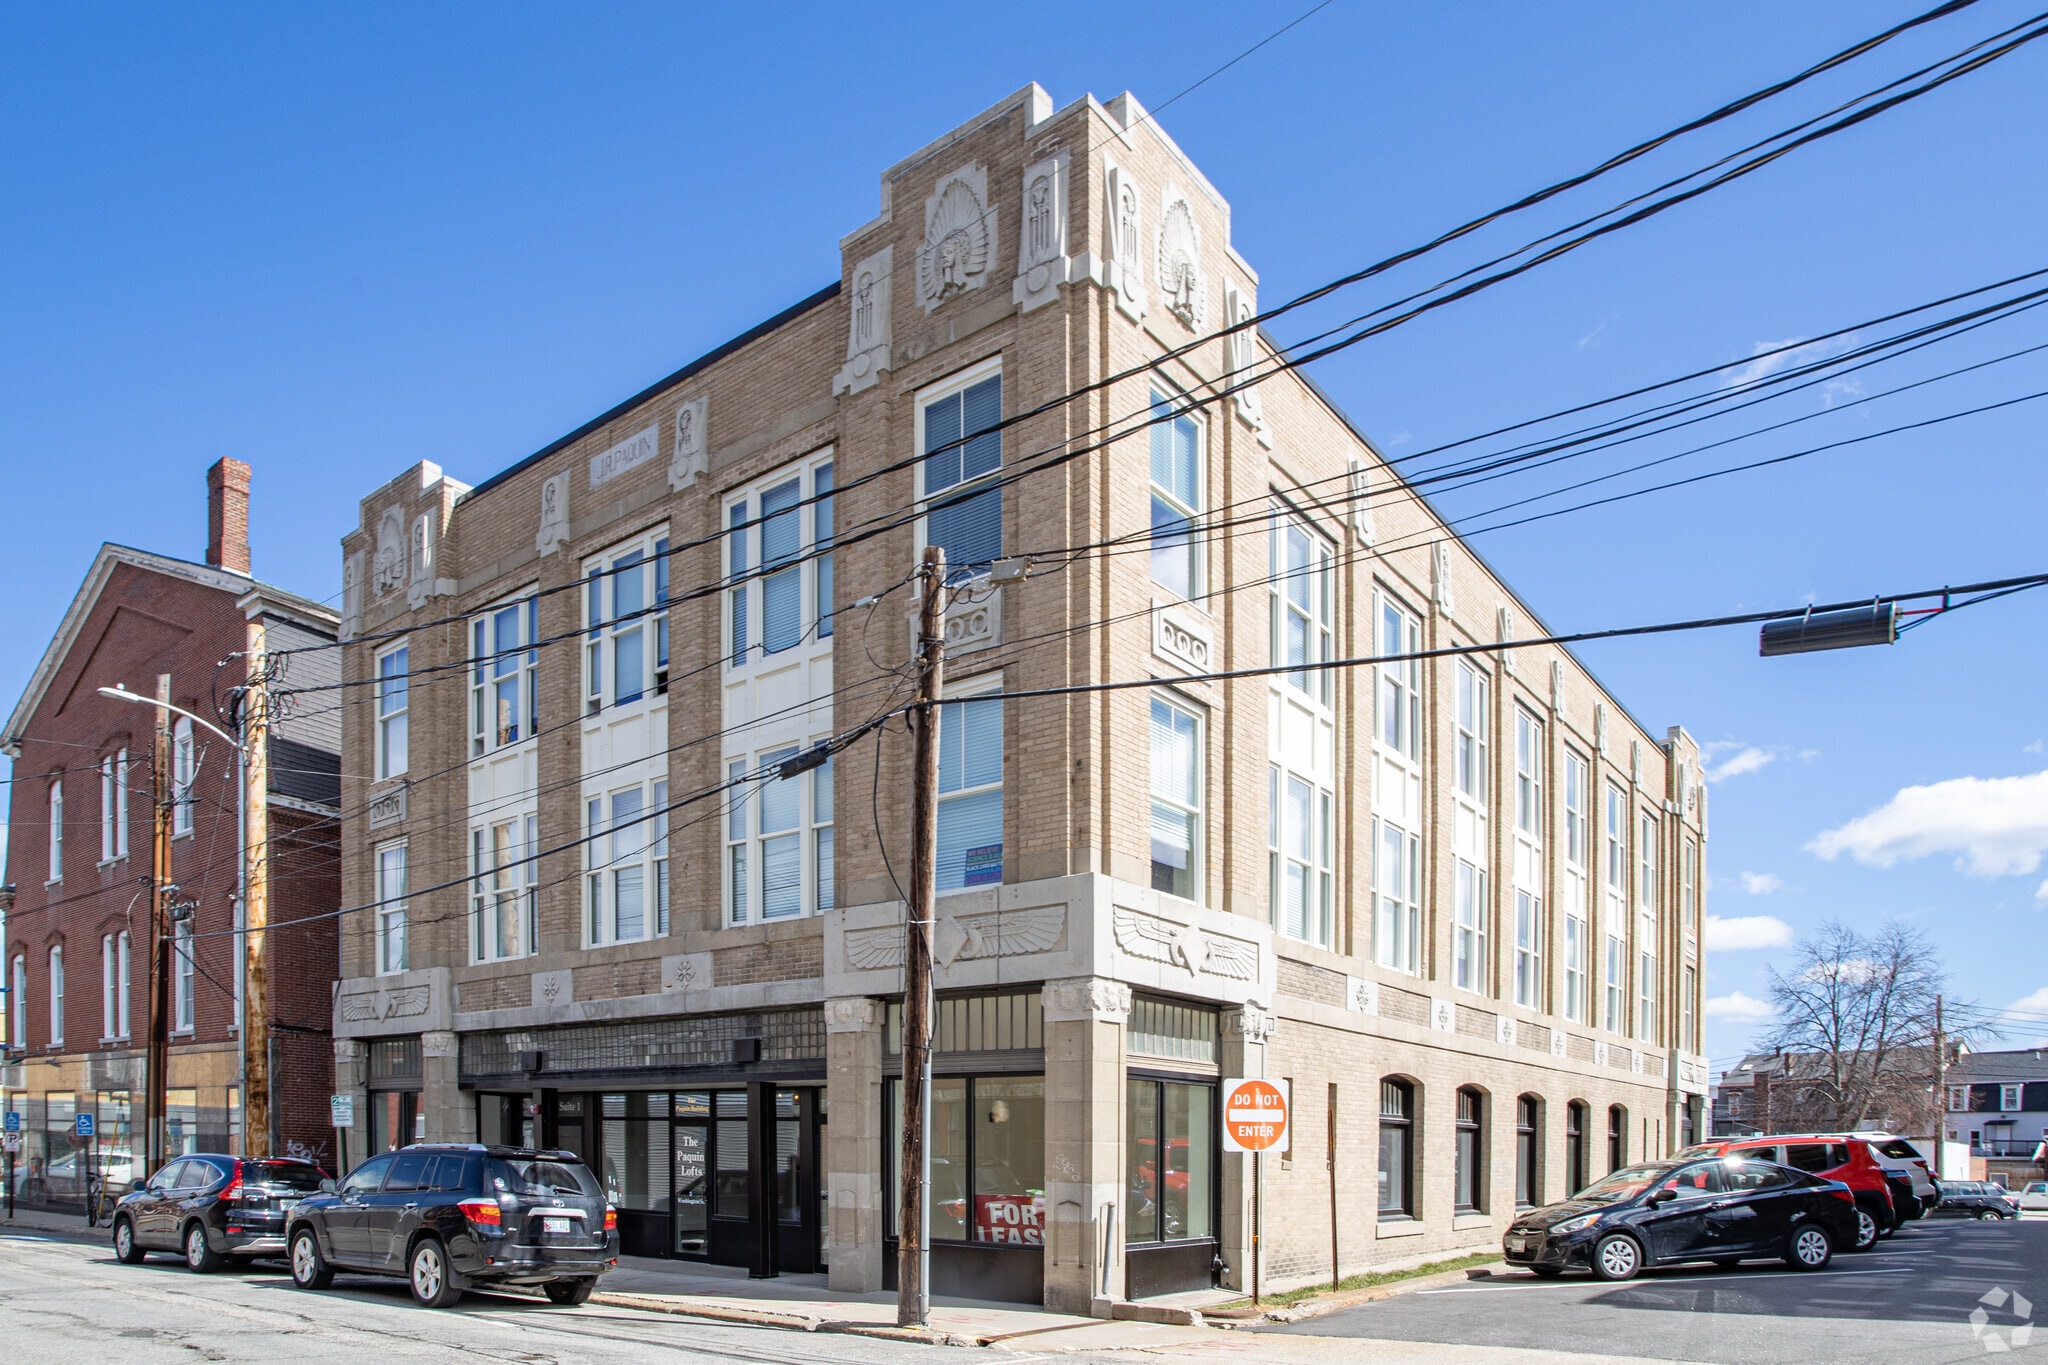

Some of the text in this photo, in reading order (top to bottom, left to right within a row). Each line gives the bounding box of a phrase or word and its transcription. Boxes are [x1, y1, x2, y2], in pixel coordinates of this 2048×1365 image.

[332, 1097, 339, 1105] 2
[1234, 1094, 1279, 1106] DO NOT
[560, 1102, 575, 1111] Suite
[1238, 1125, 1274, 1137] ENTER
[682, 1136, 699, 1147] The
[677, 1150, 705, 1163] Paquin
[681, 1166, 703, 1176] Lofts
[989, 1203, 1038, 1226] FOR
[977, 1225, 1046, 1246] LEAS
